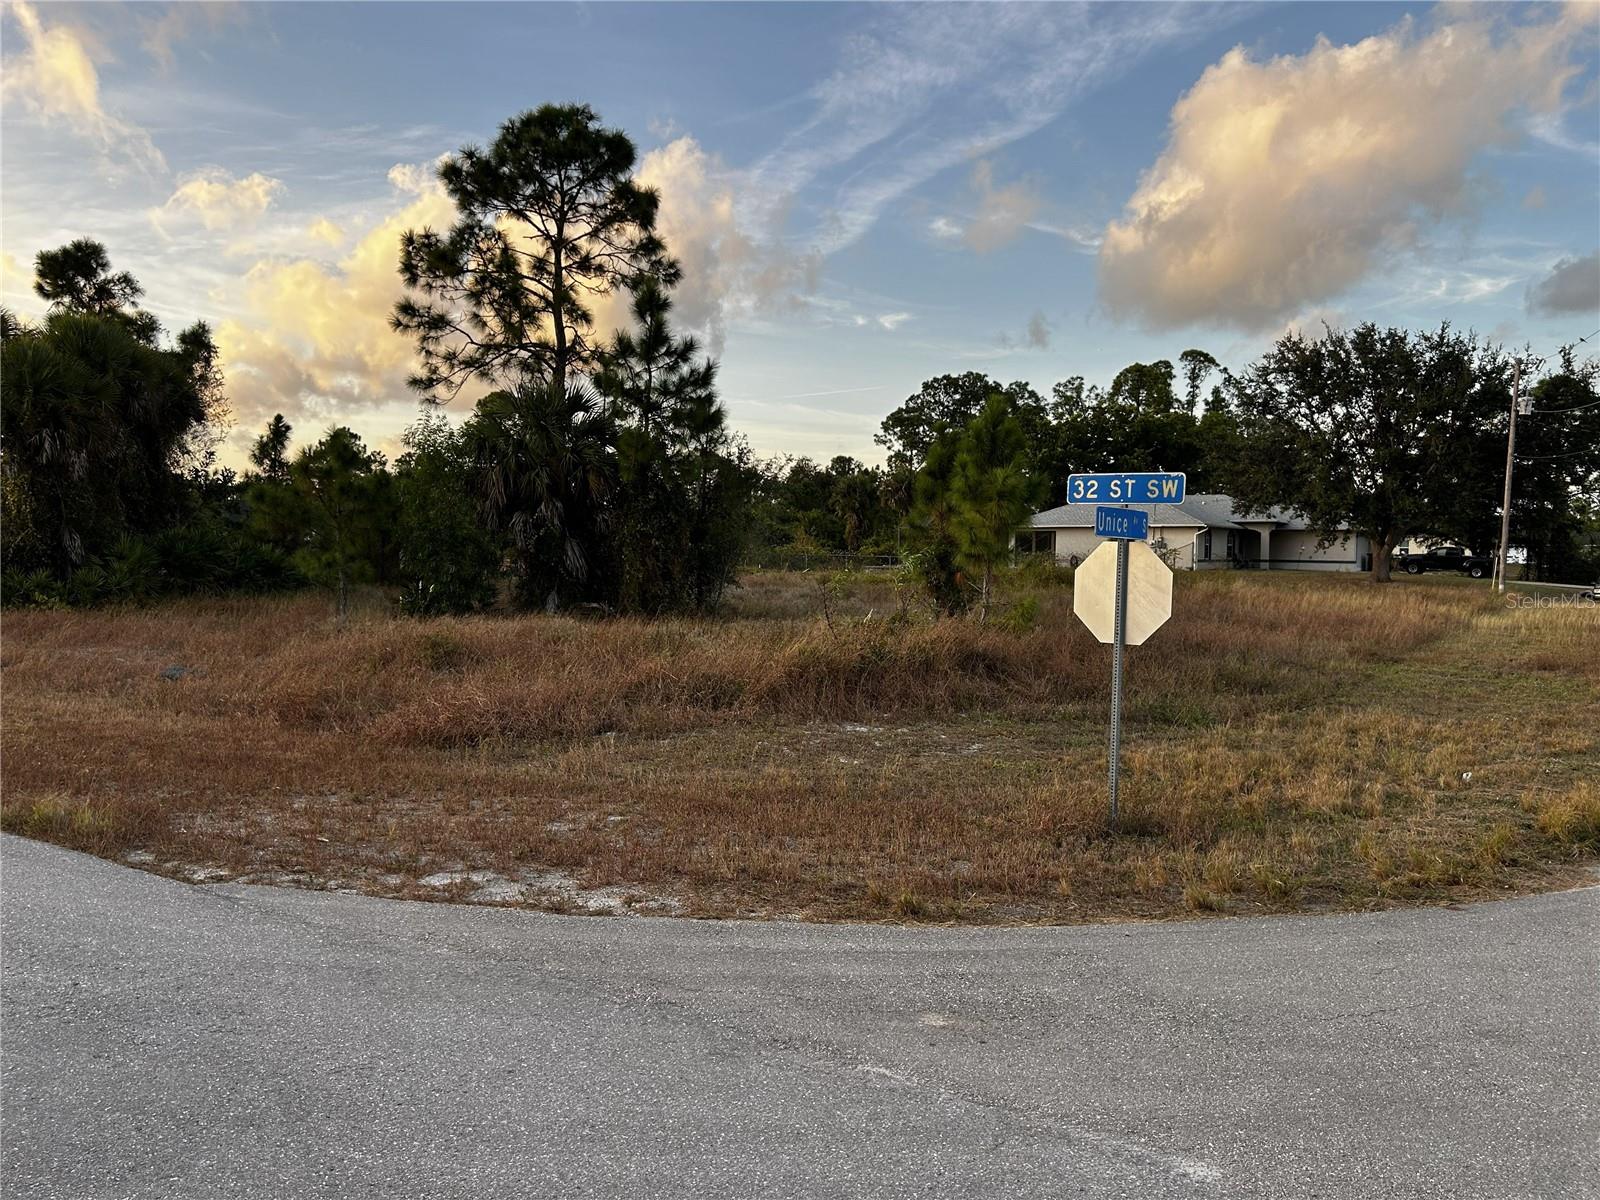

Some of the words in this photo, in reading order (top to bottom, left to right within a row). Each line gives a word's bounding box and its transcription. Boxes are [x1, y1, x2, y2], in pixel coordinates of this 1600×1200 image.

[1073, 480, 1098, 499] 32
[1110, 479, 1136, 498] ST
[1147, 479, 1178, 498] SW
[1098, 511, 1128, 533] Unice
